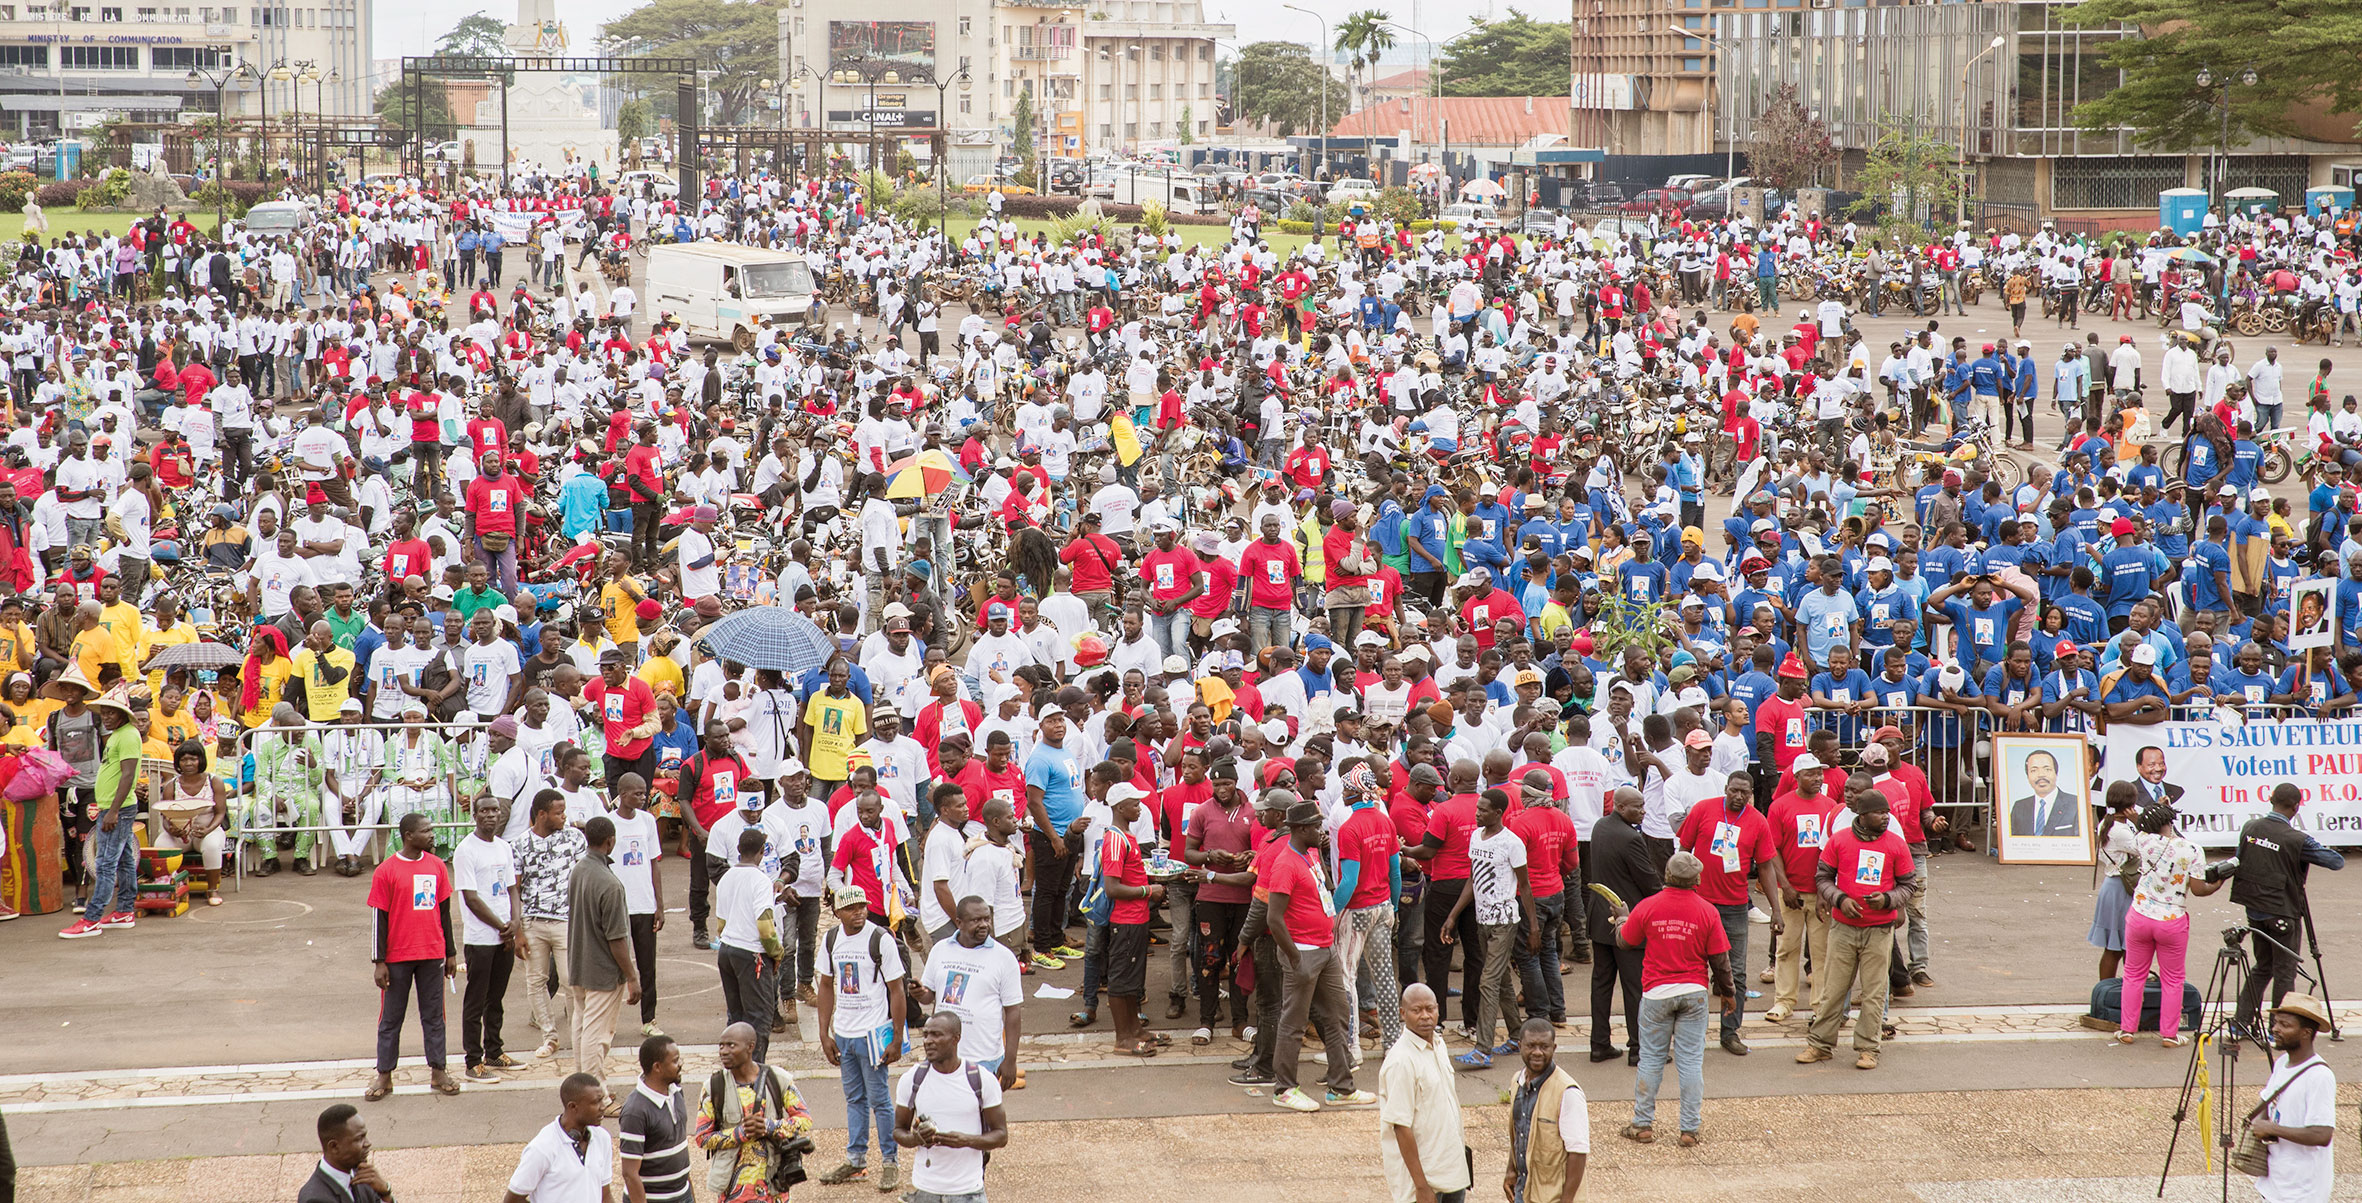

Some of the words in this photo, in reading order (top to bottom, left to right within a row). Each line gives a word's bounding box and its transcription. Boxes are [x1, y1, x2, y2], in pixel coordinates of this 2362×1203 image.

[80, 12, 92, 21] DE
[104, 12, 117, 21] LA
[27, 34, 70, 43] MINISTRY
[83, 35, 95, 43] OF
[108, 35, 182, 44] COMMUNICATION
[1420, 378, 1429, 390] 11
[898, 620, 906, 629] H
[1519, 672, 1537, 683] BOY
[2166, 727, 2212, 748] LES
[2221, 754, 2298, 776] Votent
[2220, 785, 2249, 803] Un
[2256, 784, 2311, 806] Cp
[2180, 813, 2241, 832] PAUL
[2316, 812, 2362, 831] fera
